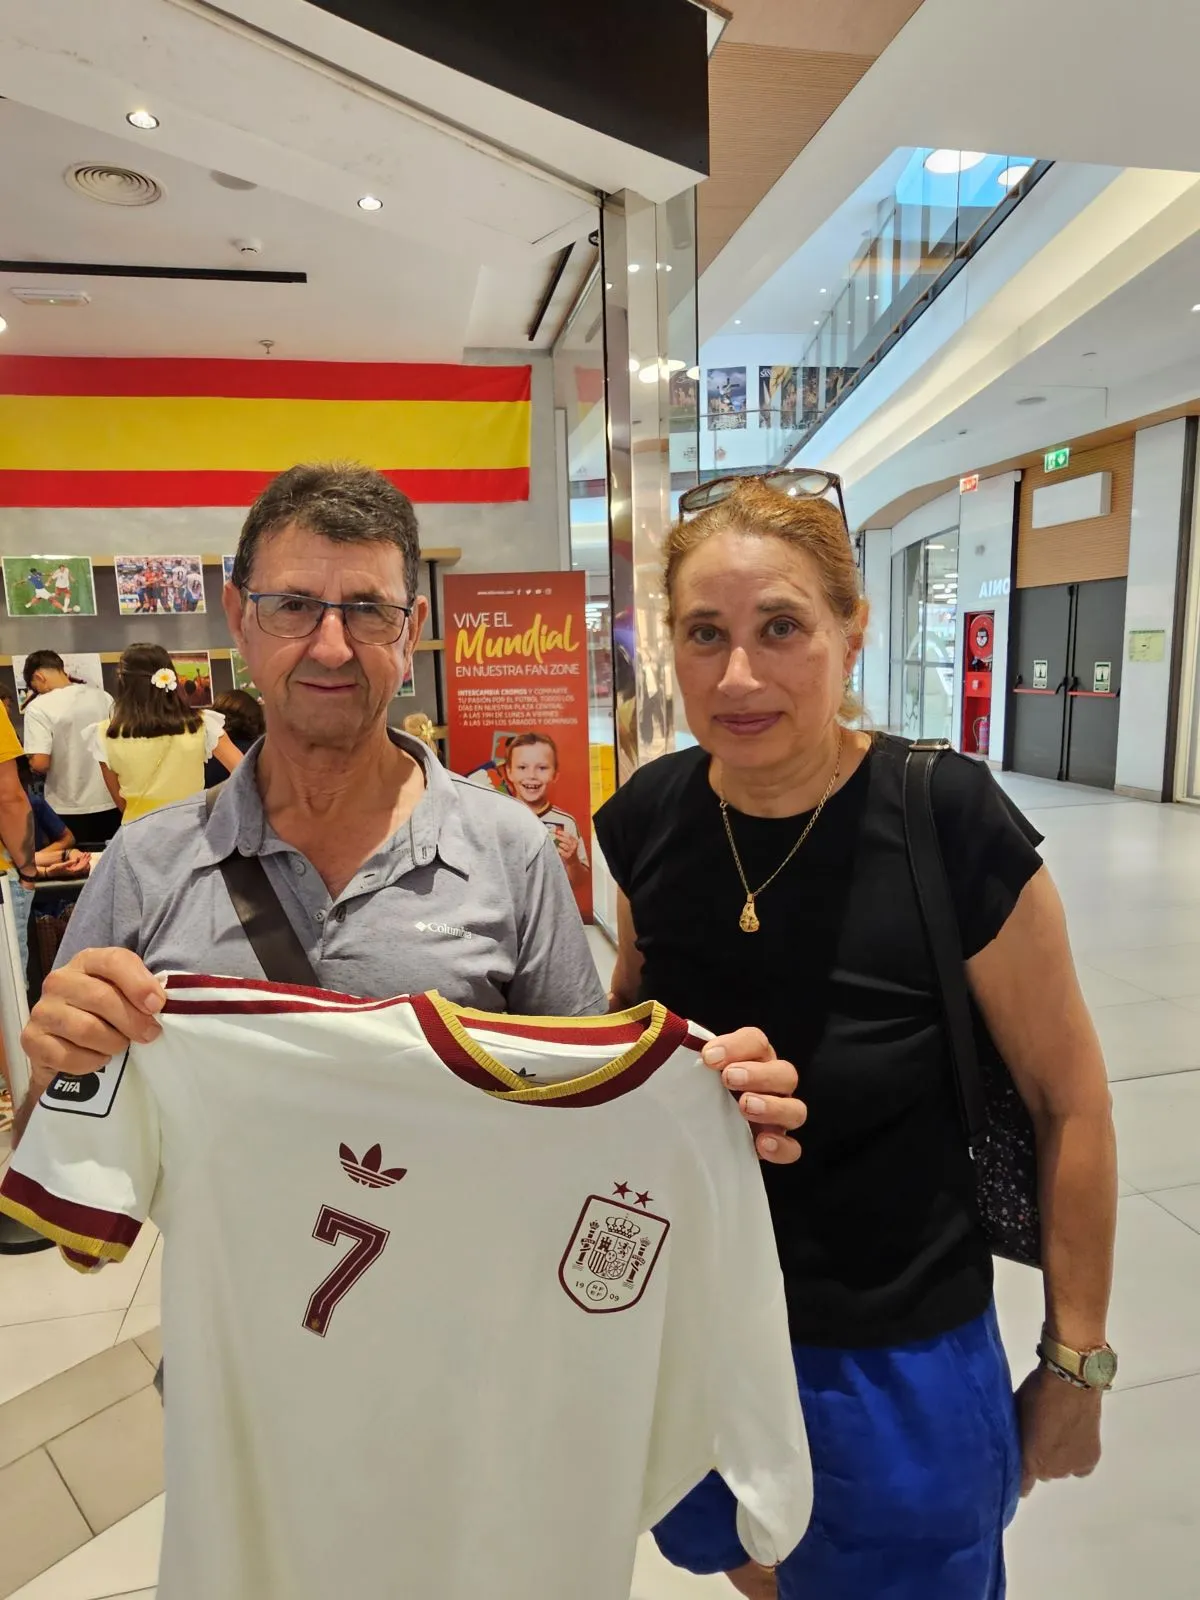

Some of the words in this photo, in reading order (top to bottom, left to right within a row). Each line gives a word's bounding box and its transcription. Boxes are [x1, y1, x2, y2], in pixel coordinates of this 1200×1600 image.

[453, 612, 490, 628] VIVE
[494, 612, 513, 628] EL
[455, 613, 580, 665] Mundial
[455, 666, 471, 678] EN
[473, 664, 523, 677] NUESTRA
[525, 664, 548, 675] FAN
[549, 663, 580, 675] ZONE
[53, 1079, 81, 1093] FIFA
[302, 1204, 390, 1338] 7
